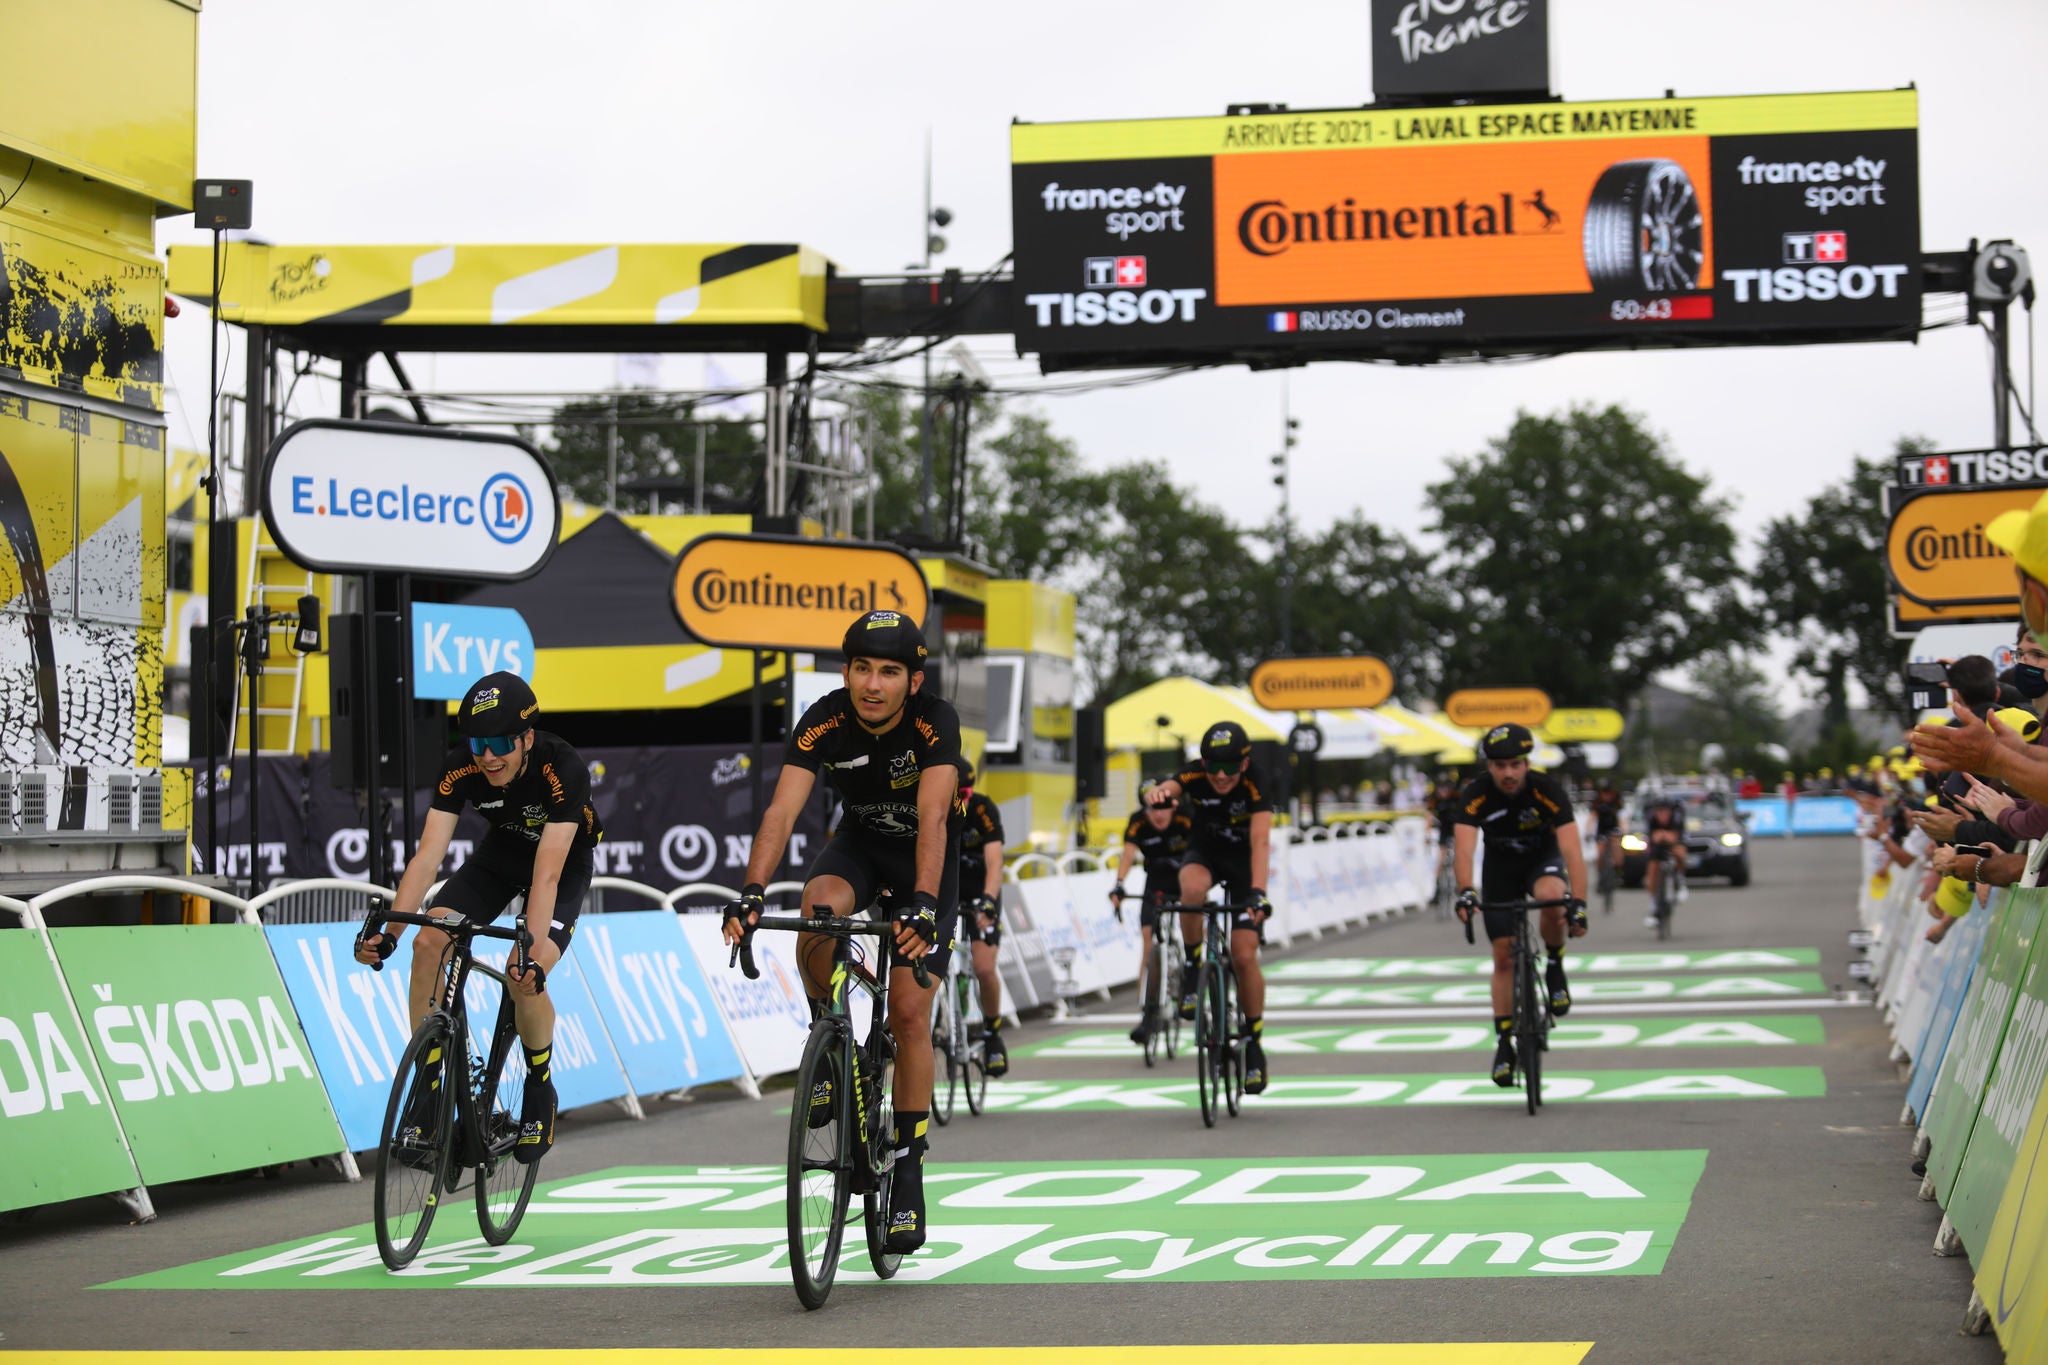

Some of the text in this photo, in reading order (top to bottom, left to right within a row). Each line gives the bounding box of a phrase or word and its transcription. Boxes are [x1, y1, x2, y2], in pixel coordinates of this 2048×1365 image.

[1224, 117, 1318, 148] ARRIVÉE
[1323, 119, 1372, 143] 2021
[1394, 115, 1469, 141] LAVAL
[1479, 112, 1563, 136] ESPACE
[1572, 107, 1697, 132] MAYENNE
[1804, 183, 1886, 214] sport
[1106, 206, 1185, 240] sport
[1237, 192, 1515, 257] Continental
[1722, 264, 1908, 303] TISSOT
[1025, 288, 1207, 327] TISSOT
[1299, 308, 1371, 332] RUSSO
[292, 475, 475, 526] E.Leclerc
[692, 568, 877, 614] Continental
[584, 925, 708, 1079] Krys
[92, 983, 313, 1102] ŠKODA
